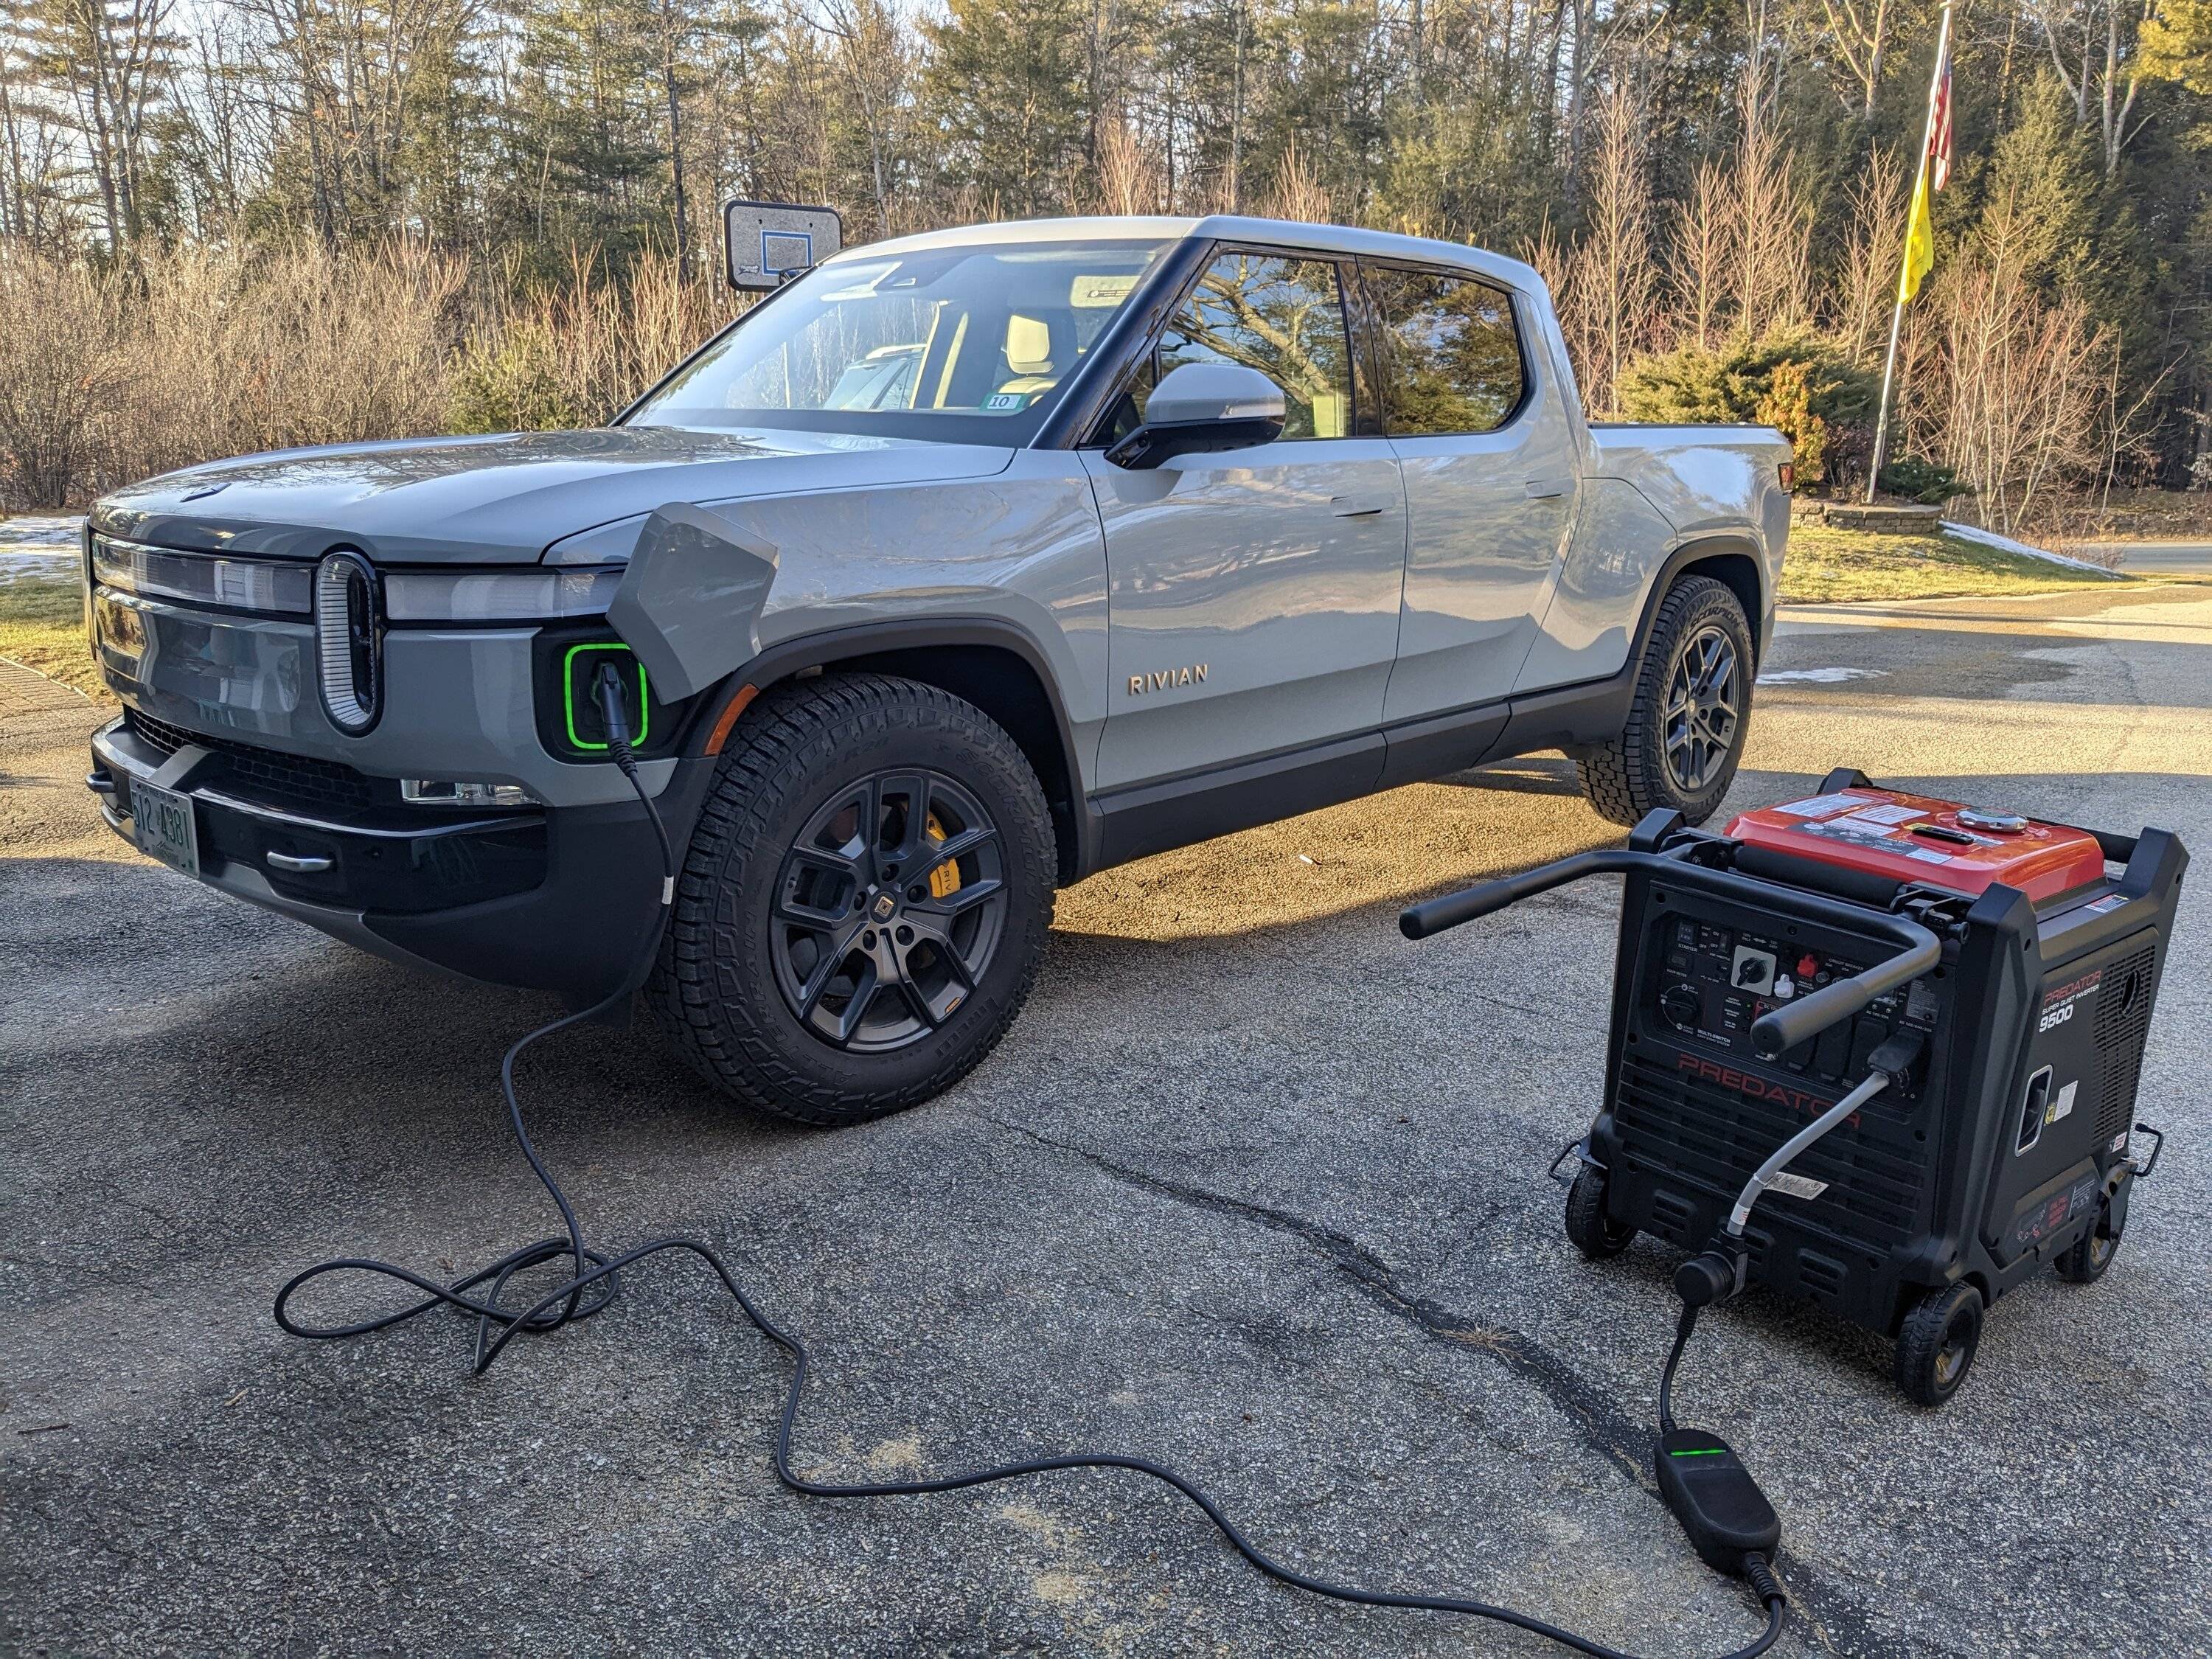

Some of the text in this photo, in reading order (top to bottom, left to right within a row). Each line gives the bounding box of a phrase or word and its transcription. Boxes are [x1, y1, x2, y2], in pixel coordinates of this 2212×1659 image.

[989, 396, 1010, 407] 10
[1128, 664, 1208, 695] RIVIAN
[1678, 943, 1697, 953] STARTER
[2042, 984, 2100, 1015] SUPER QUIET INVERTER
[2043, 970, 2101, 1006] PREDATOR
[2039, 1004, 2074, 1033] 9500
[1697, 1029, 1731, 1043] MULTI-SWITCH
